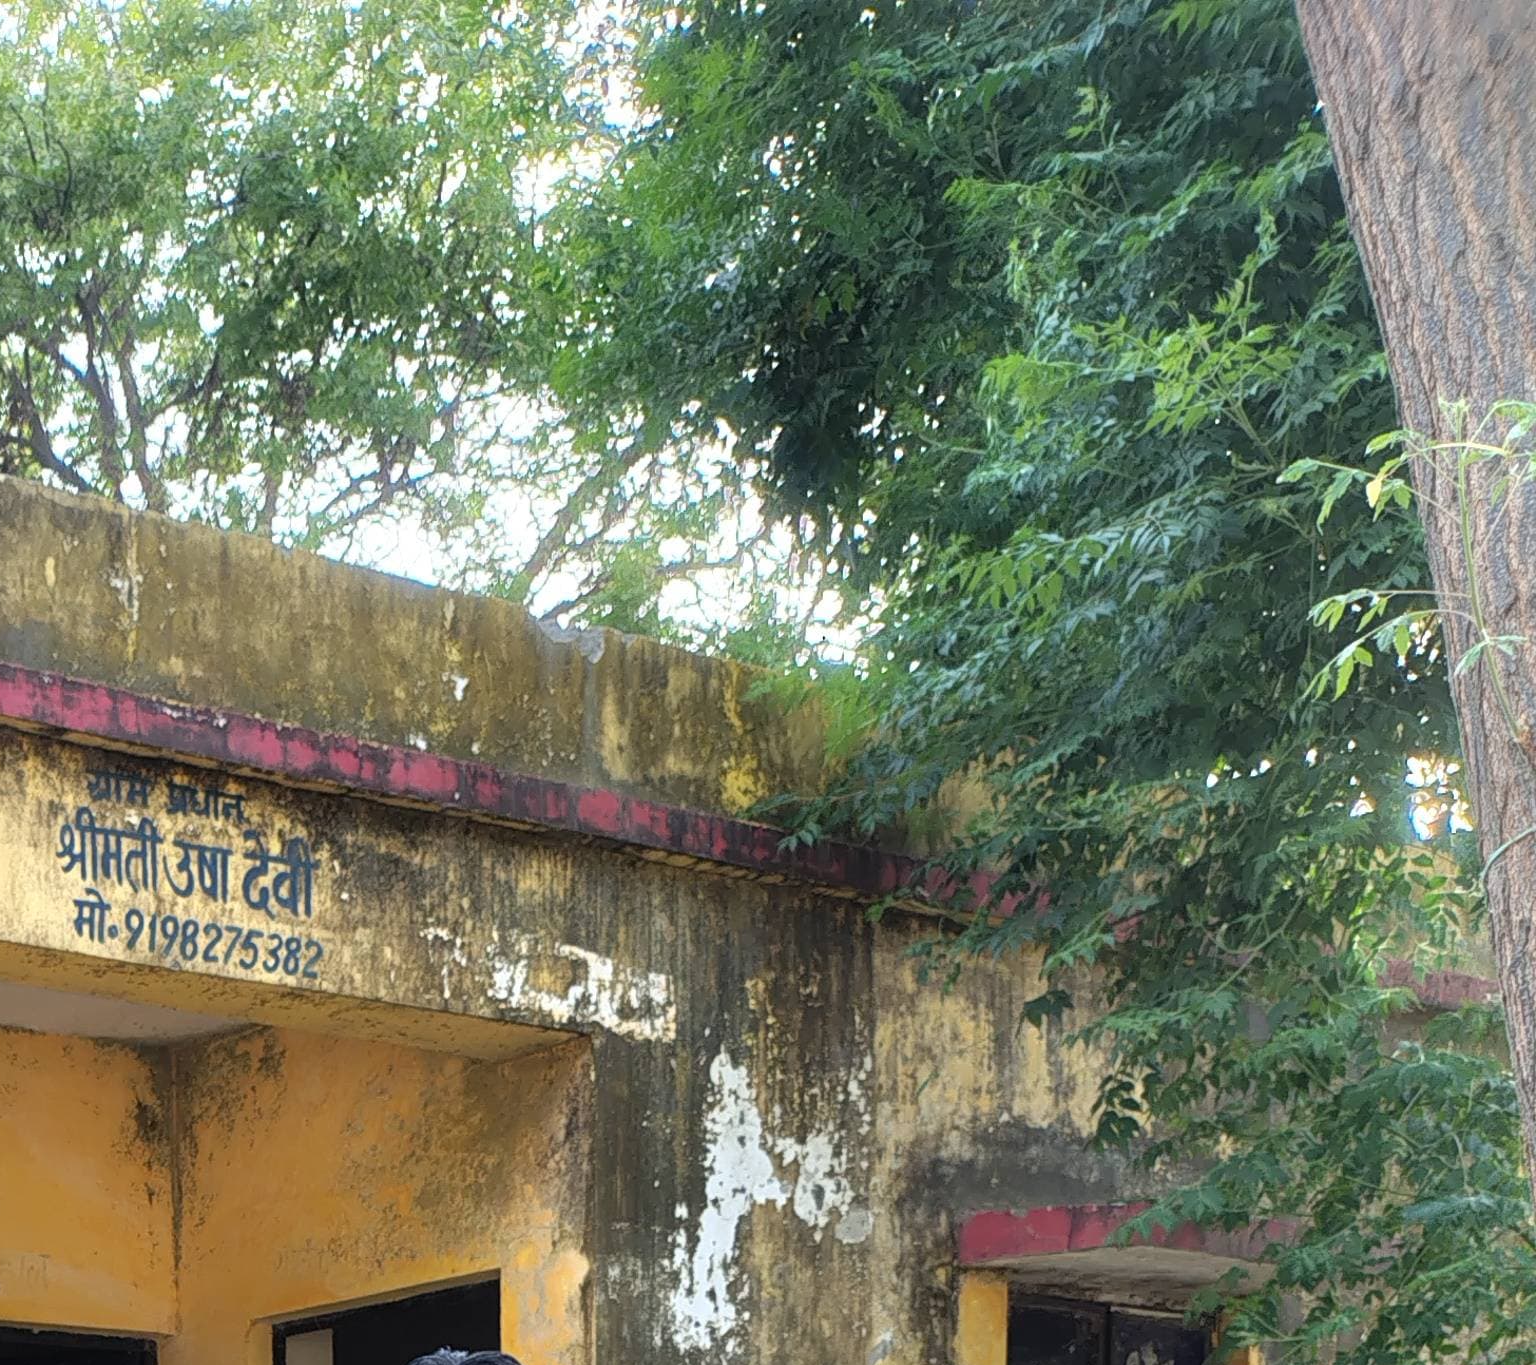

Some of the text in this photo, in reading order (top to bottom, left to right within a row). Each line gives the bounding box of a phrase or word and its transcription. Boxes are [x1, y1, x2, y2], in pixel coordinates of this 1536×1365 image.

[56, 806, 321, 919] श्रीमती उषा देवी
